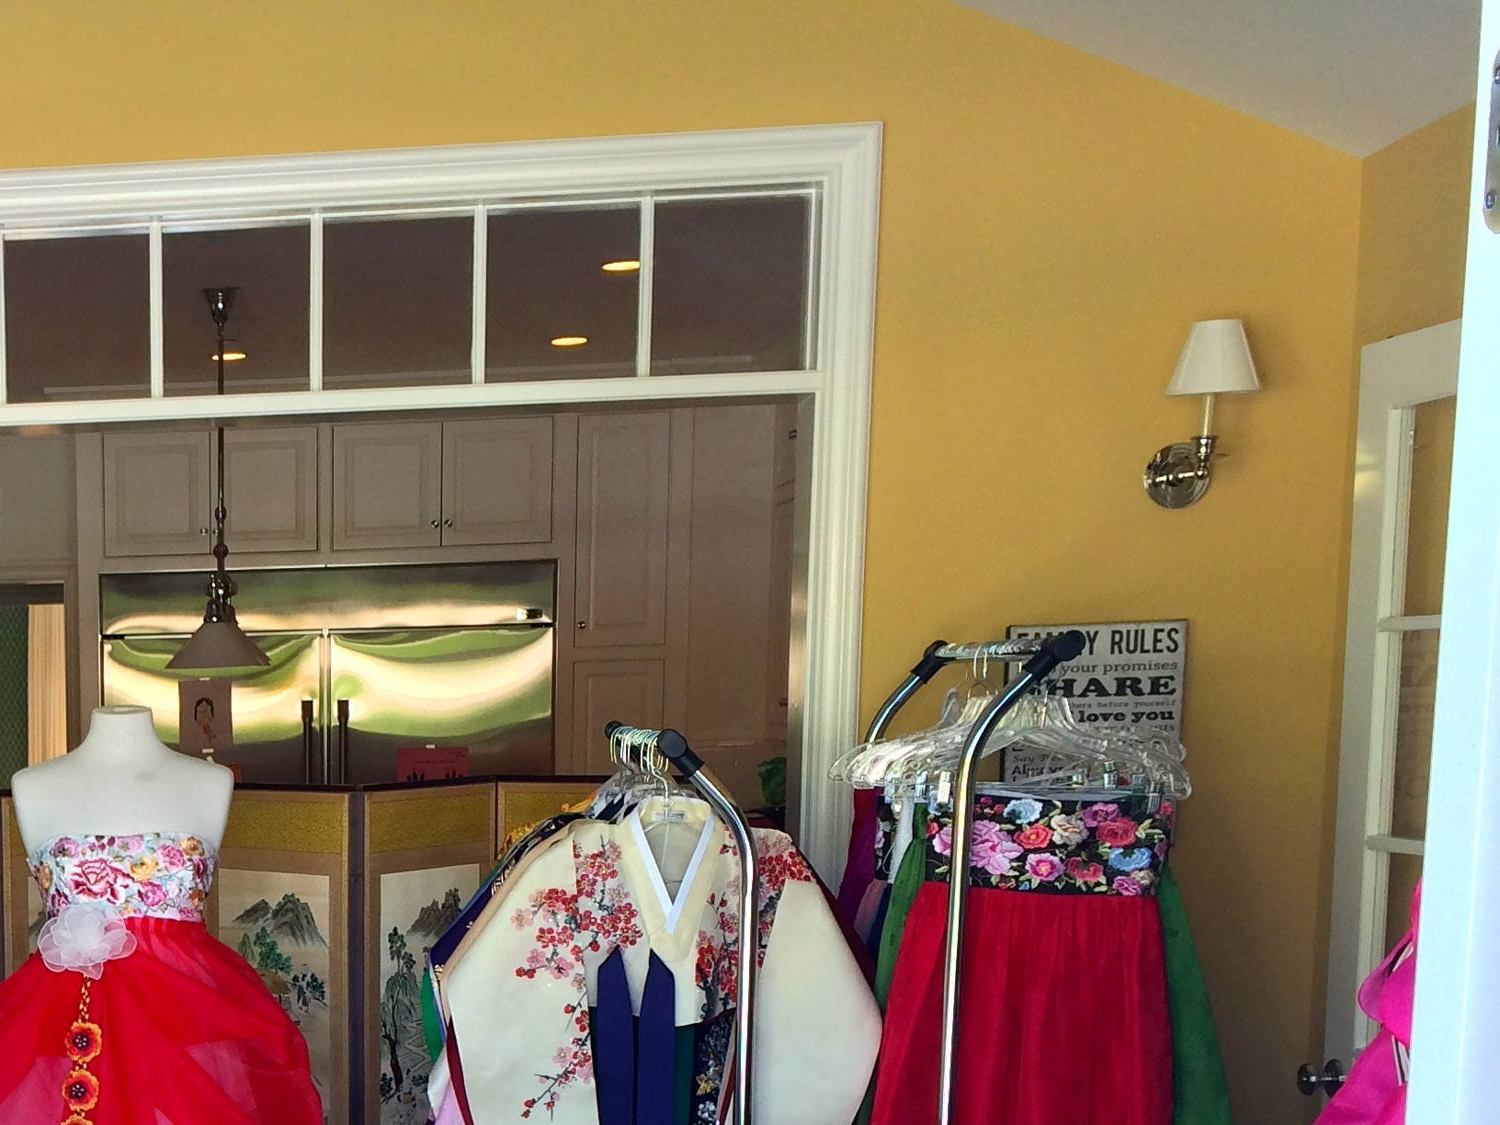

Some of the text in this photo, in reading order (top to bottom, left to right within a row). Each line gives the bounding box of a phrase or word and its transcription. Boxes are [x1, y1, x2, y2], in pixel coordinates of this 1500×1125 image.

[1110, 627, 1180, 655] RULES
[1061, 664, 1098, 677] your
[1103, 661, 1178, 675] promises
[1133, 699, 1176, 709] yourself
[1078, 710, 1126, 723] love
[1131, 710, 1175, 723] you
